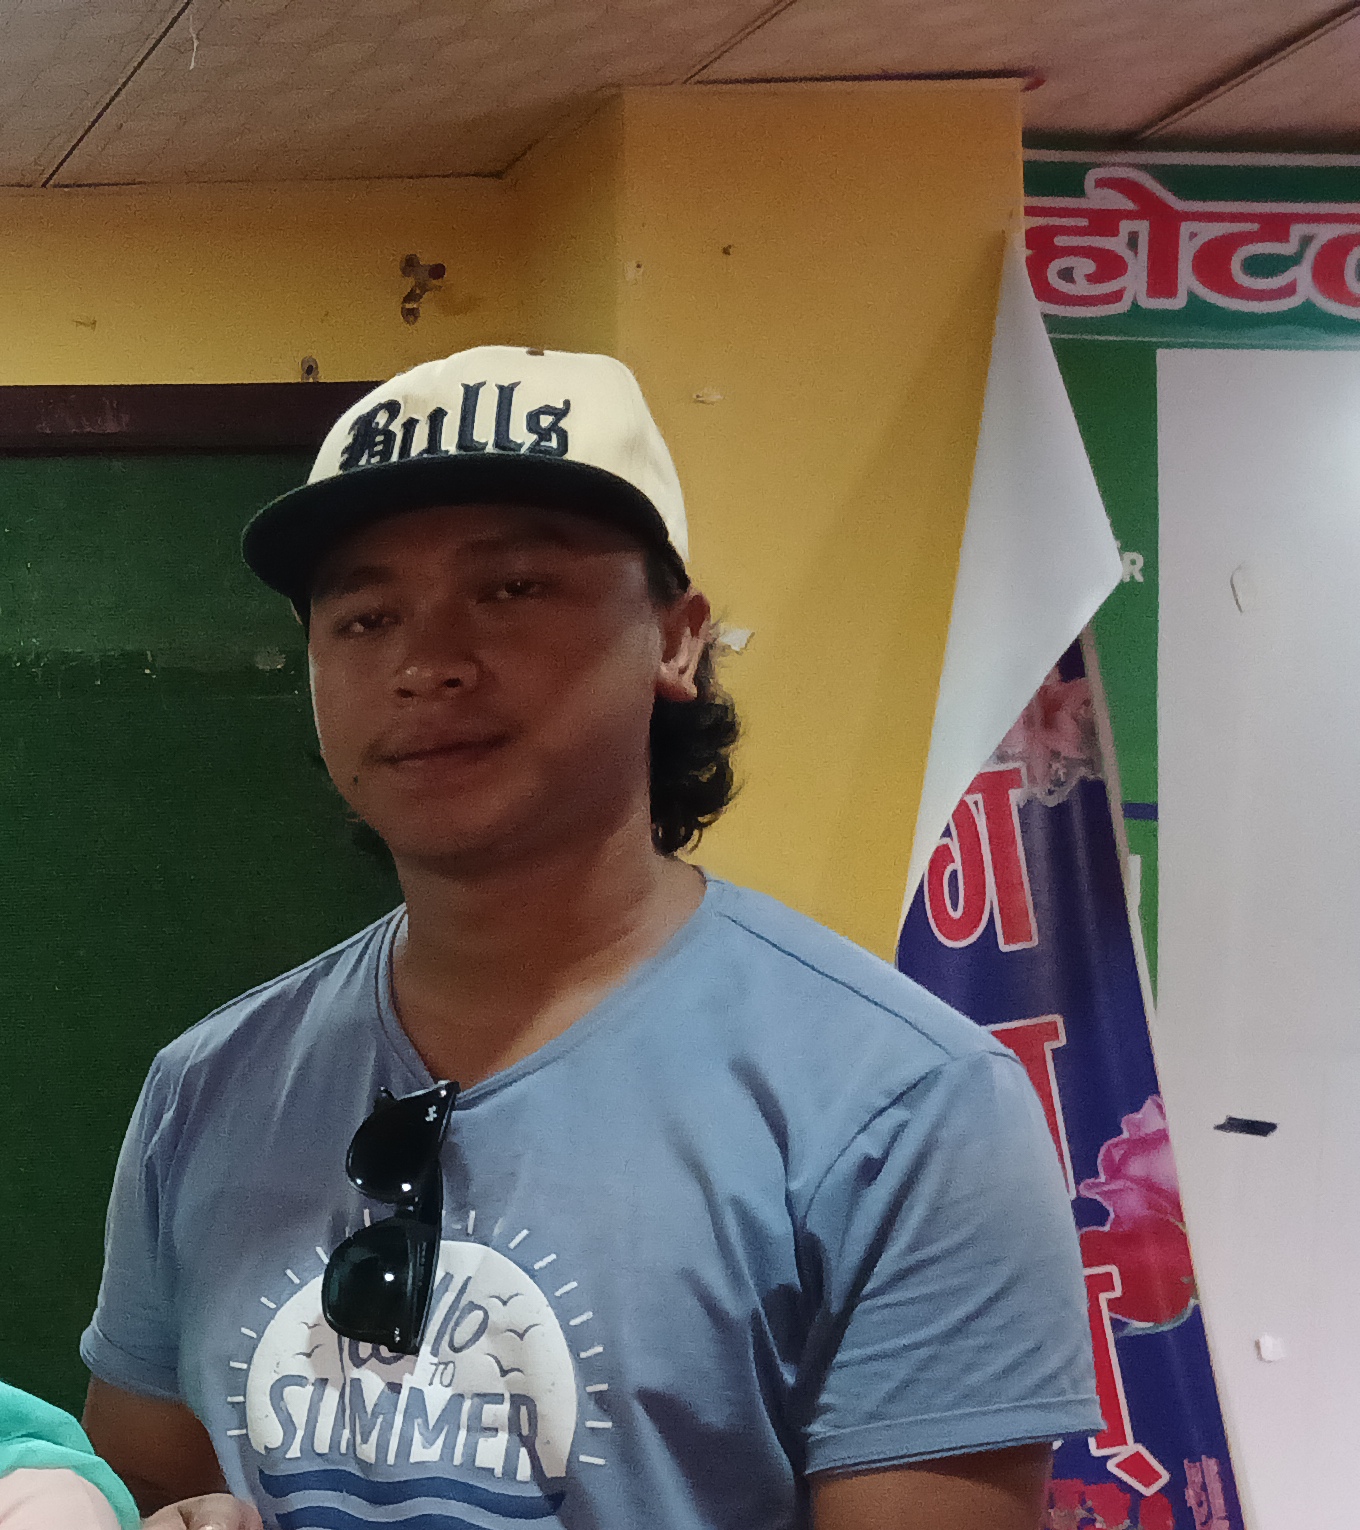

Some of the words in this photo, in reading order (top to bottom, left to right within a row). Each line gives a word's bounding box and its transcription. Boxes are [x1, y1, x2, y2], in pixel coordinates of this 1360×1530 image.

[339, 380, 571, 472] Bulls
[428, 1360, 456, 1388] TO
[262, 1374, 538, 1481] SUMMER
